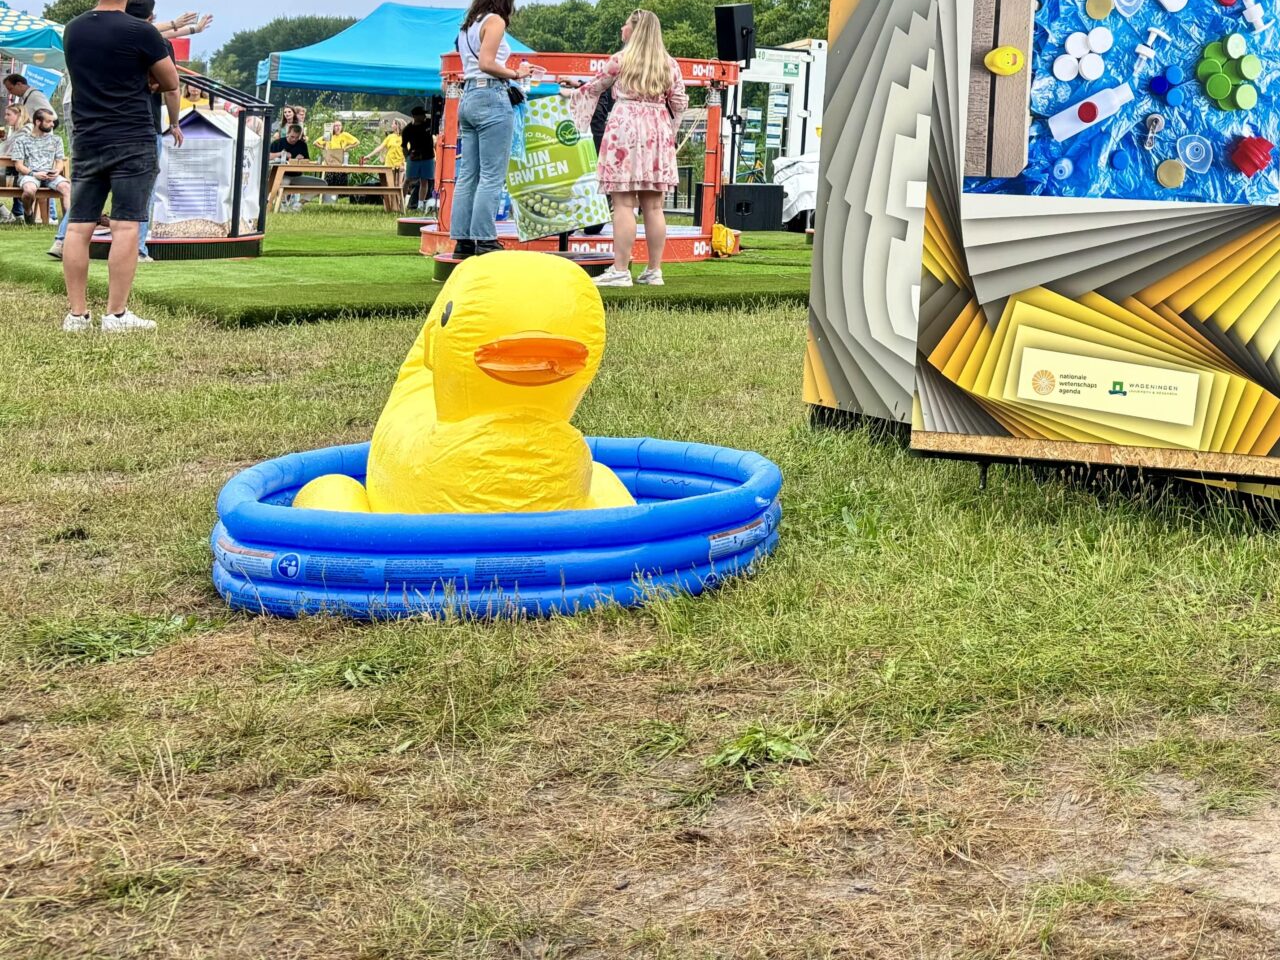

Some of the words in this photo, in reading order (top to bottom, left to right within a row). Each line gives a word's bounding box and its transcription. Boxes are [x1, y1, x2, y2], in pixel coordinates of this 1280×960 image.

[508, 159, 569, 186] ERWTEN
[1059, 373, 1087, 381] nationale
[1058, 381, 1097, 389] wetenschaps
